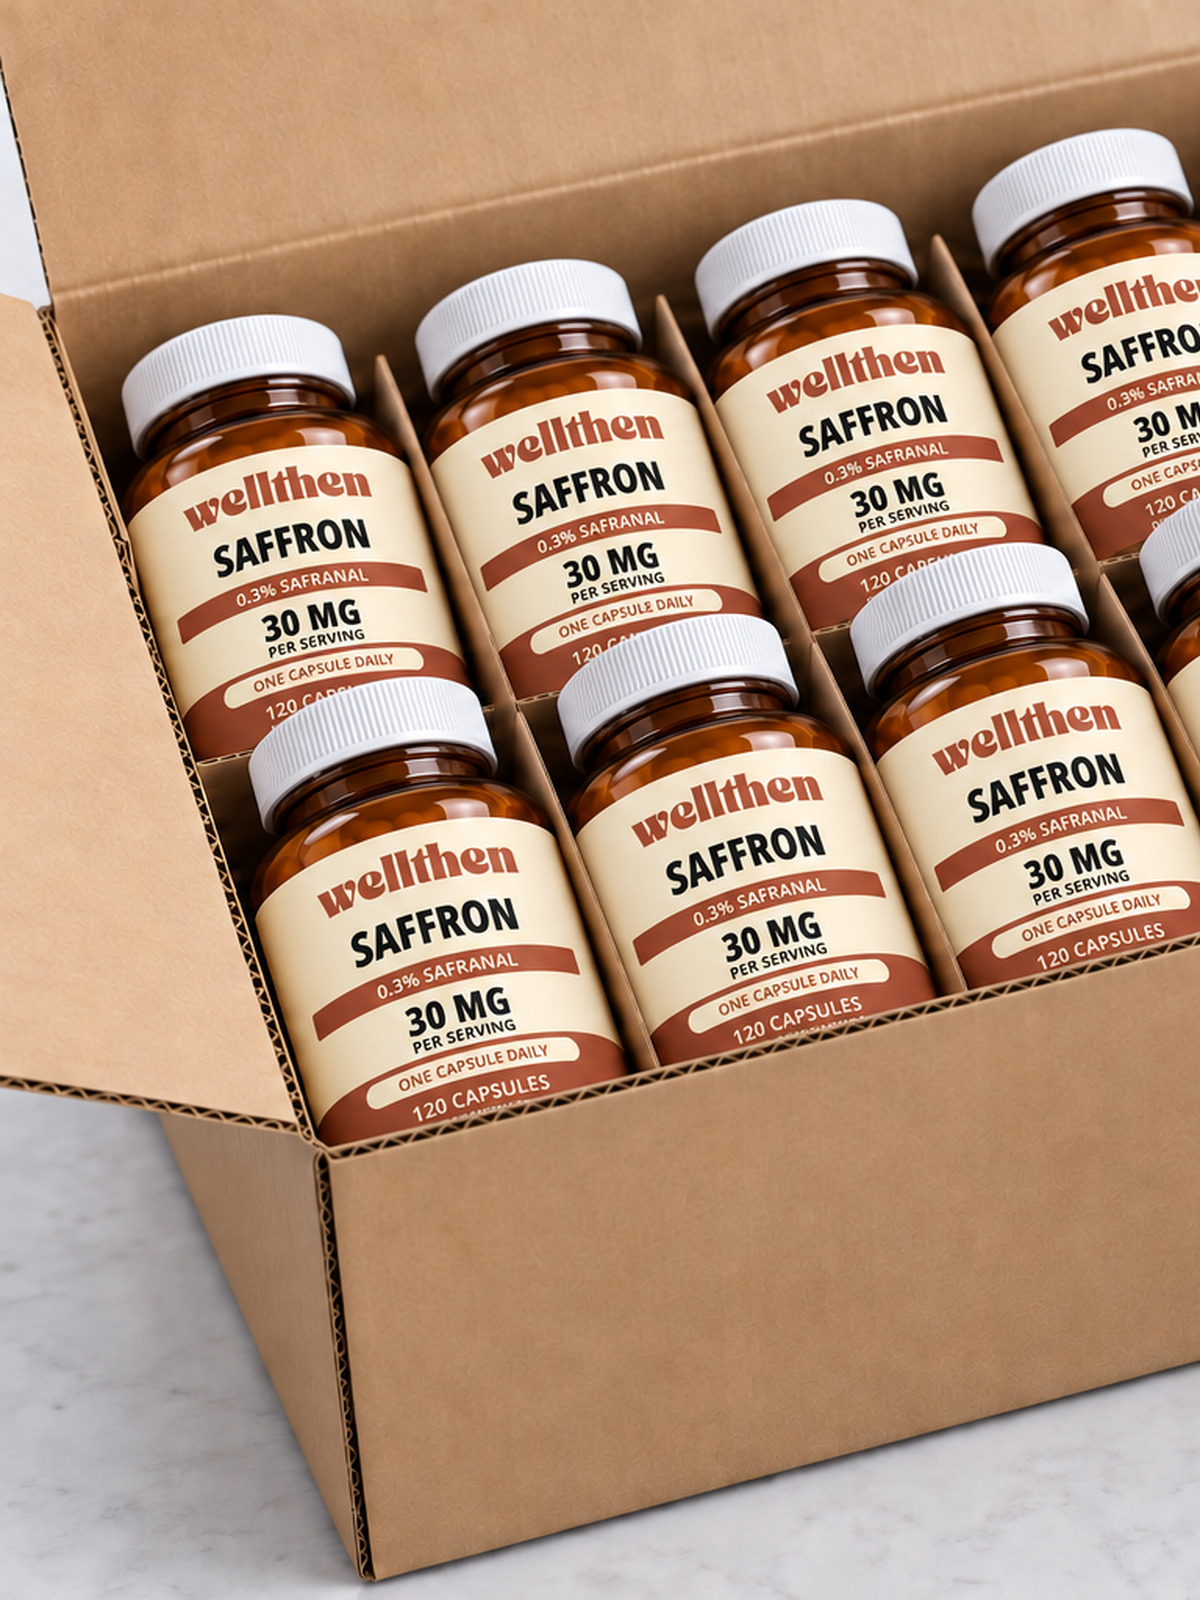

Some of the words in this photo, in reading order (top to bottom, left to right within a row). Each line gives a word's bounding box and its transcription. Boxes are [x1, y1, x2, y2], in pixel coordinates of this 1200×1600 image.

[767, 346, 945, 414] wellthen
[1107, 388, 1145, 411] 0.3%
[481, 411, 664, 479] wellthen
[799, 395, 947, 457] SAFFRON
[1133, 411, 1170, 443] 30
[824, 462, 862, 485] 0.3%
[865, 442, 949, 469] SAFRANAL
[1142, 442, 1169, 458] PER
[184, 466, 372, 532] wellthen
[512, 462, 665, 525] SAFFRON
[850, 485, 887, 518] 30
[893, 473, 945, 505] MG
[1131, 473, 1161, 491] ONE
[859, 516, 886, 533] PER
[889, 500, 950, 523] SERVING
[1145, 495, 1176, 516] 120
[214, 519, 371, 577] SAFFRON
[537, 530, 576, 553] 0.3%
[579, 512, 665, 537] SAFRANAL
[846, 549, 877, 566] ONE
[879, 529, 939, 554] CAPSULE
[942, 523, 979, 538] DAILY
[236, 583, 277, 607] 0.3%
[280, 568, 368, 593] SAFRANAL
[563, 555, 600, 588] 30
[607, 543, 659, 574] MG
[571, 589, 598, 603] PER
[601, 572, 665, 594] SERVING
[861, 571, 891, 592] 120
[262, 610, 300, 642] 30
[309, 600, 361, 628] MG
[559, 621, 590, 638] ONE
[592, 601, 653, 626] CAPSULE
[656, 596, 694, 611] DAILY
[268, 643, 297, 658] PER
[300, 629, 365, 652] SERVING
[573, 644, 602, 665] 120
[253, 674, 286, 693] ONE
[289, 658, 352, 682] CAPSULE
[355, 653, 394, 667] DAILY
[266, 699, 297, 720] 120
[932, 702, 1122, 776] wellthen
[631, 773, 823, 848] wellthen
[967, 753, 1125, 823] SAFFRON
[995, 829, 1037, 853] 0.3%
[1040, 806, 1127, 836] SAFRANAL
[317, 842, 519, 918] wellthen
[666, 825, 826, 895] SAFFRON
[1024, 854, 1063, 889] 30
[1069, 839, 1124, 874] MG
[693, 902, 734, 926] 0.3%
[737, 878, 827, 908] SAFRANAL
[1033, 890, 1062, 905] PER
[1065, 870, 1130, 895] SERVING
[351, 898, 519, 967] SAFFRON
[722, 927, 761, 962] 30
[767, 911, 822, 947] MG
[1021, 923, 1054, 941] ONE
[1057, 901, 1120, 929] CAPSULE
[1122, 894, 1162, 911] DAILY
[730, 965, 759, 979] PER
[763, 943, 827, 968] SERVING
[1037, 949, 1069, 971] 120
[1074, 923, 1165, 957] CAPSULES
[377, 976, 420, 999] 0.3%
[423, 953, 518, 983] SAFRANAL
[718, 997, 749, 1016] ONE
[753, 975, 817, 1003] CAPSULE
[820, 967, 859, 984] DAILY
[405, 1001, 445, 1036] 30
[453, 987, 511, 1022] MG
[733, 1022, 765, 1044] 120
[769, 996, 862, 1031] CAPSULES
[413, 1037, 443, 1054] PER
[446, 1019, 516, 1043] SERVING
[399, 1071, 432, 1091] ONE
[436, 1051, 504, 1079] CAPSULE
[506, 1044, 548, 1060] DAILY
[413, 1098, 447, 1122] 120
[452, 1074, 550, 1107] CAPSULES
